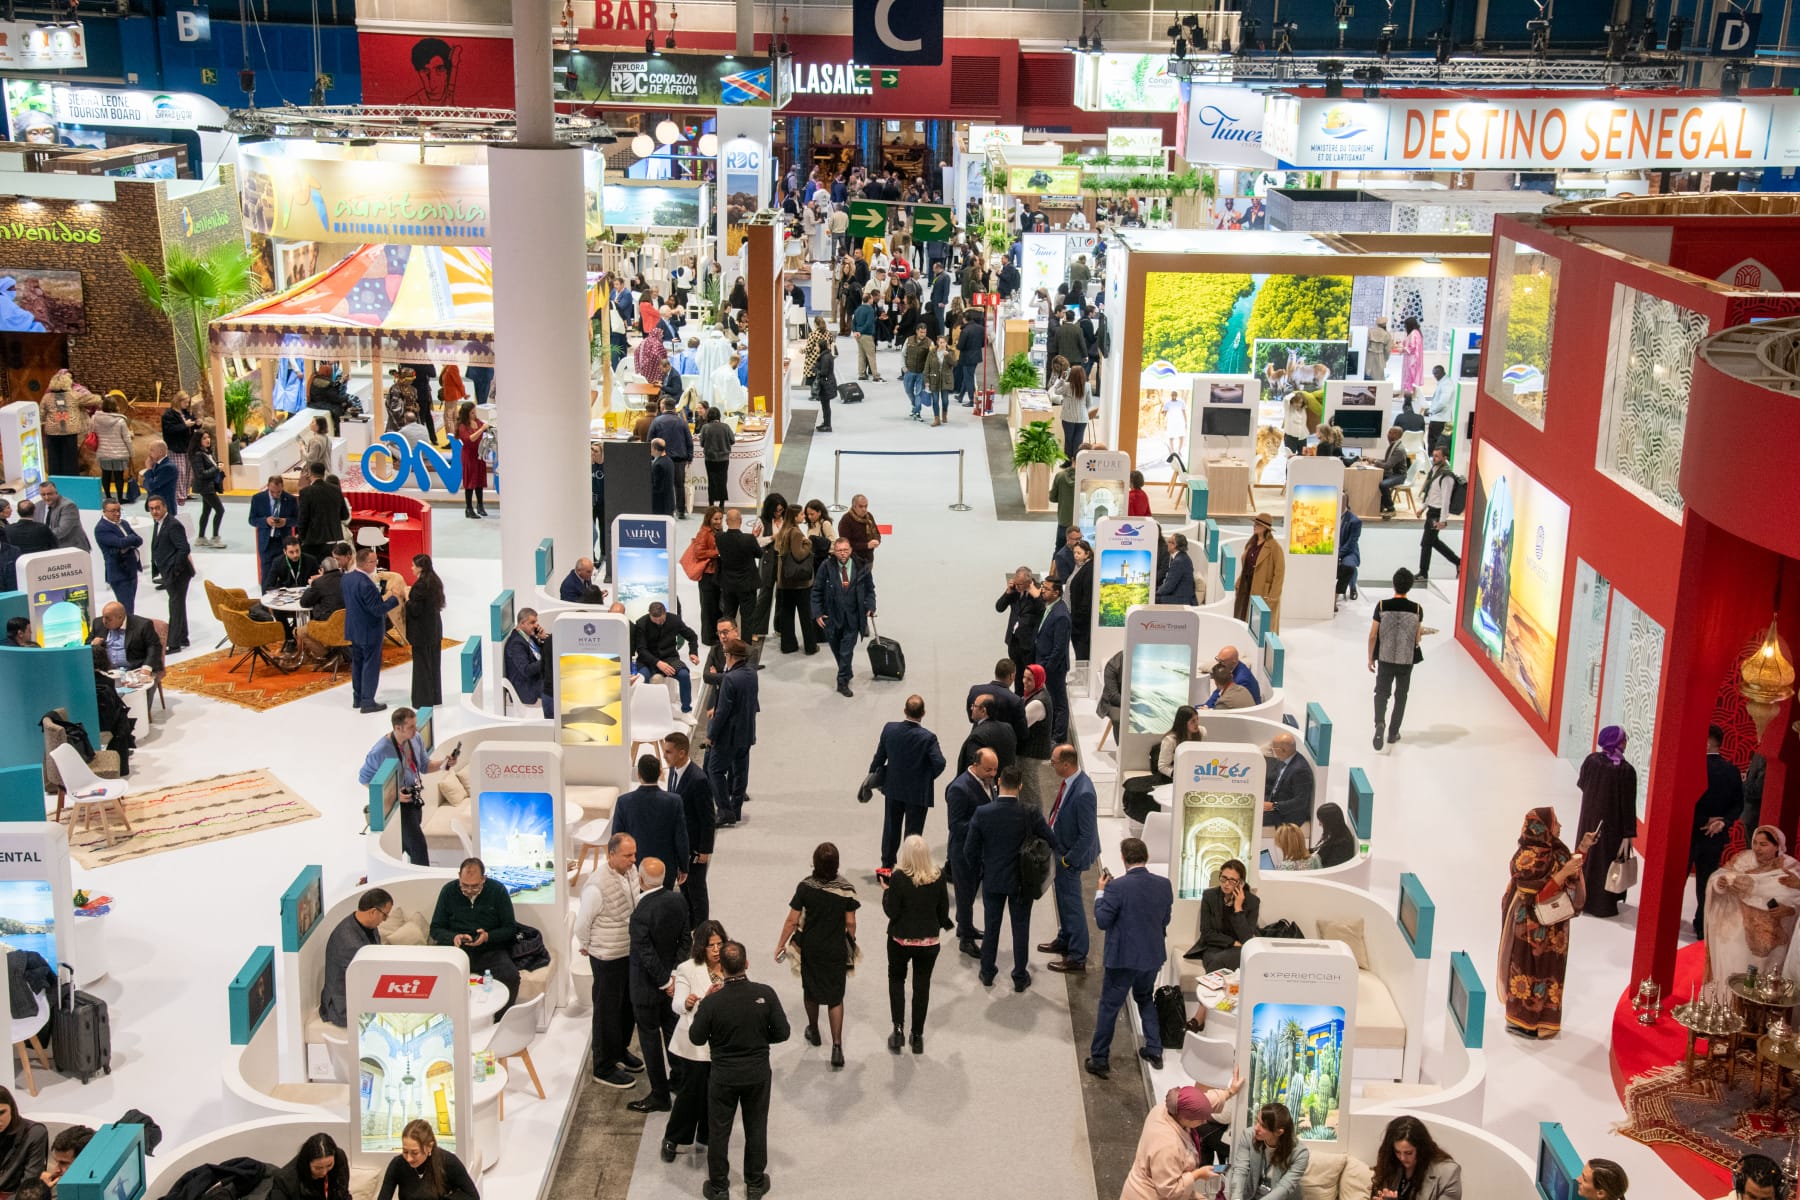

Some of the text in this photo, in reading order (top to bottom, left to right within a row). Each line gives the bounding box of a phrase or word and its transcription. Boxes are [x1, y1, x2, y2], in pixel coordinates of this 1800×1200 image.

[595, 0, 658, 30] BAR
[175, 10, 200, 42] B
[874, 0, 922, 51] C
[1720, 20, 1750, 50] D
[649, 73, 697, 85] CORAZÓN
[650, 83, 698, 95] DE ÁFRICA
[68, 93, 130, 108] SIERRA LEONE
[69, 106, 141, 120] TOURISM BOARD
[1199, 105, 1262, 143] Túnez
[1403, 107, 1752, 161] DESTINO SENEGAL
[726, 151, 759, 169] RDC
[38, 569, 83, 582] SOUSS MASSA
[503, 764, 545, 774] ACCESS
[0, 851, 42, 863] ENTAL
[387, 979, 421, 994] kti
